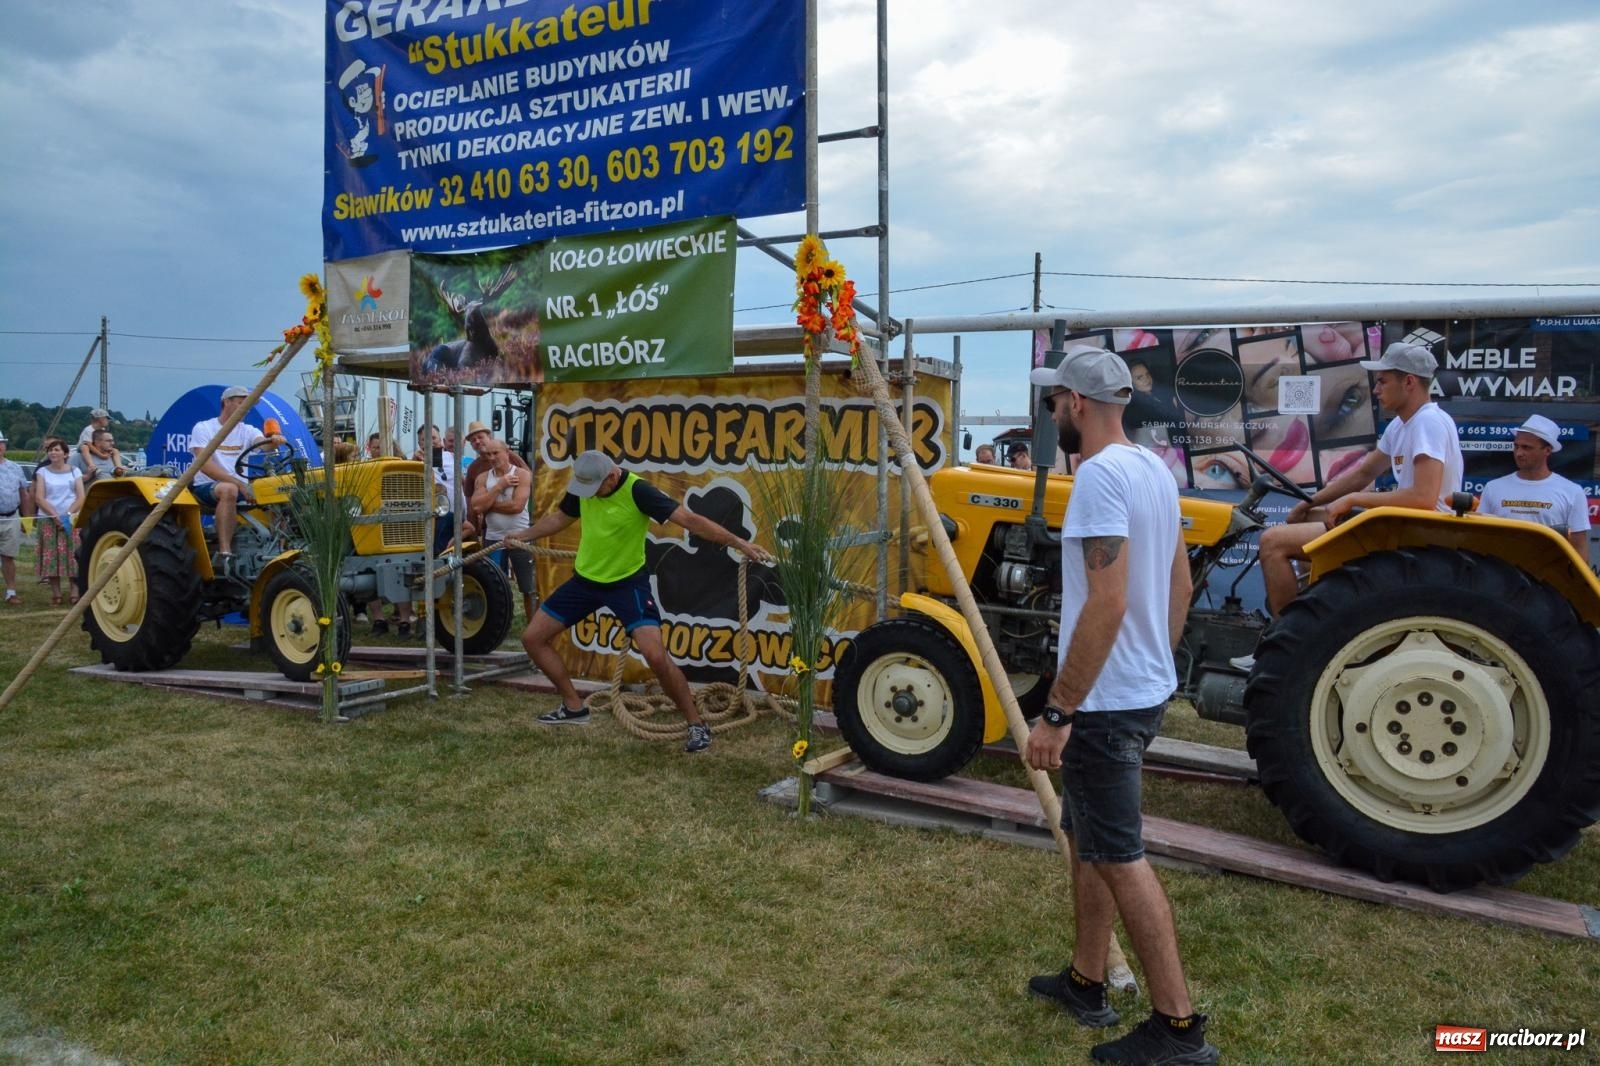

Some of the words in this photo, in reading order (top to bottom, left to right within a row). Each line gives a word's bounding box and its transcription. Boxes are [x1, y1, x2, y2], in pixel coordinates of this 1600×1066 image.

[393, 70, 520, 112] OCIEPLANIE
[526, 39, 670, 89] BUDYNKÓW
[394, 104, 522, 142] PRODUKCJA
[528, 68, 692, 119] SZTUKATERII
[397, 140, 452, 171] TYNKI
[457, 116, 623, 159] DEKORACYJNE
[630, 102, 693, 131] ZEW.
[702, 100, 710, 120] I
[718, 85, 794, 117] WEW.
[333, 185, 434, 221] Sławików
[439, 174, 465, 203] 32
[470, 168, 511, 201] 410
[519, 161, 550, 193] 63
[558, 155, 598, 192] 30,
[607, 144, 660, 183] 603
[669, 136, 725, 175] 703
[737, 125, 794, 164] 192
[401, 190, 685, 243] www.sztukateria-fitzon.pl
[549, 245, 604, 273] KOŁO
[607, 230, 727, 266] ŁOWIECKIE
[546, 294, 585, 320] NR.
[591, 295, 600, 317] 1
[548, 335, 666, 369] RACIBÓRZ
[1446, 347, 1537, 369] MEBLE
[1457, 376, 1577, 397] WYMIAR
[1141, 420, 1176, 429] SABINA
[1172, 435, 1192, 444] 503
[1195, 435, 1212, 444] 138
[1467, 426, 1486, 436] 665
[993, 497, 1019, 509] 330
